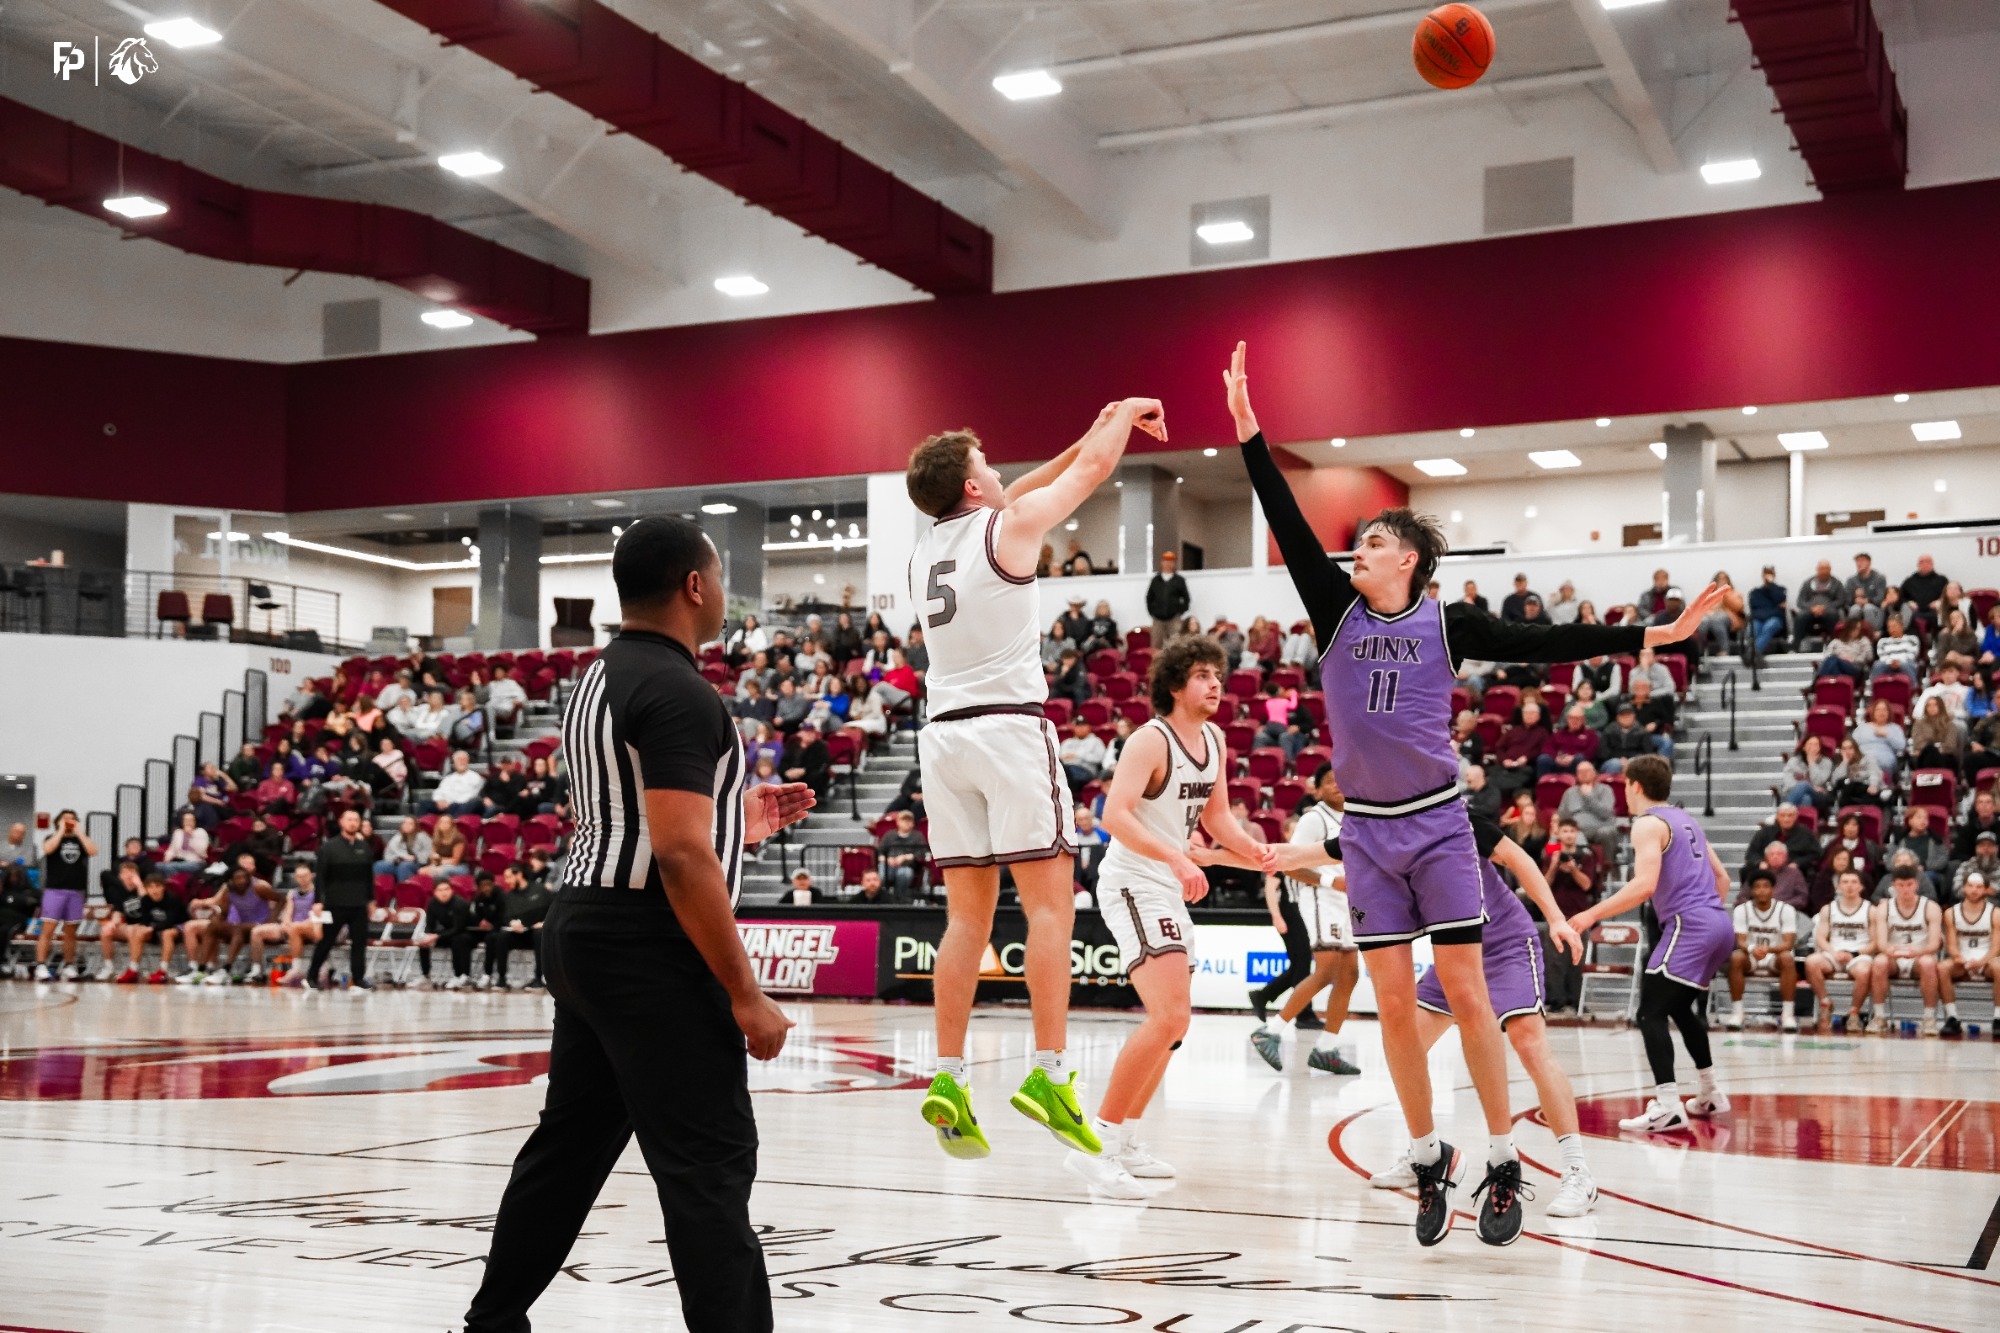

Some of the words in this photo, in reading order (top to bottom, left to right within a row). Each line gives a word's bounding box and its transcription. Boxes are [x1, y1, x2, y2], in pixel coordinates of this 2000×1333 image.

[871, 594, 895, 610] 101
[926, 559, 957, 629] 5
[1353, 634, 1422, 665] JINX
[1366, 668, 1400, 714] 11
[1682, 823, 1703, 859] 2
[1071, 940, 1129, 976] SIG
